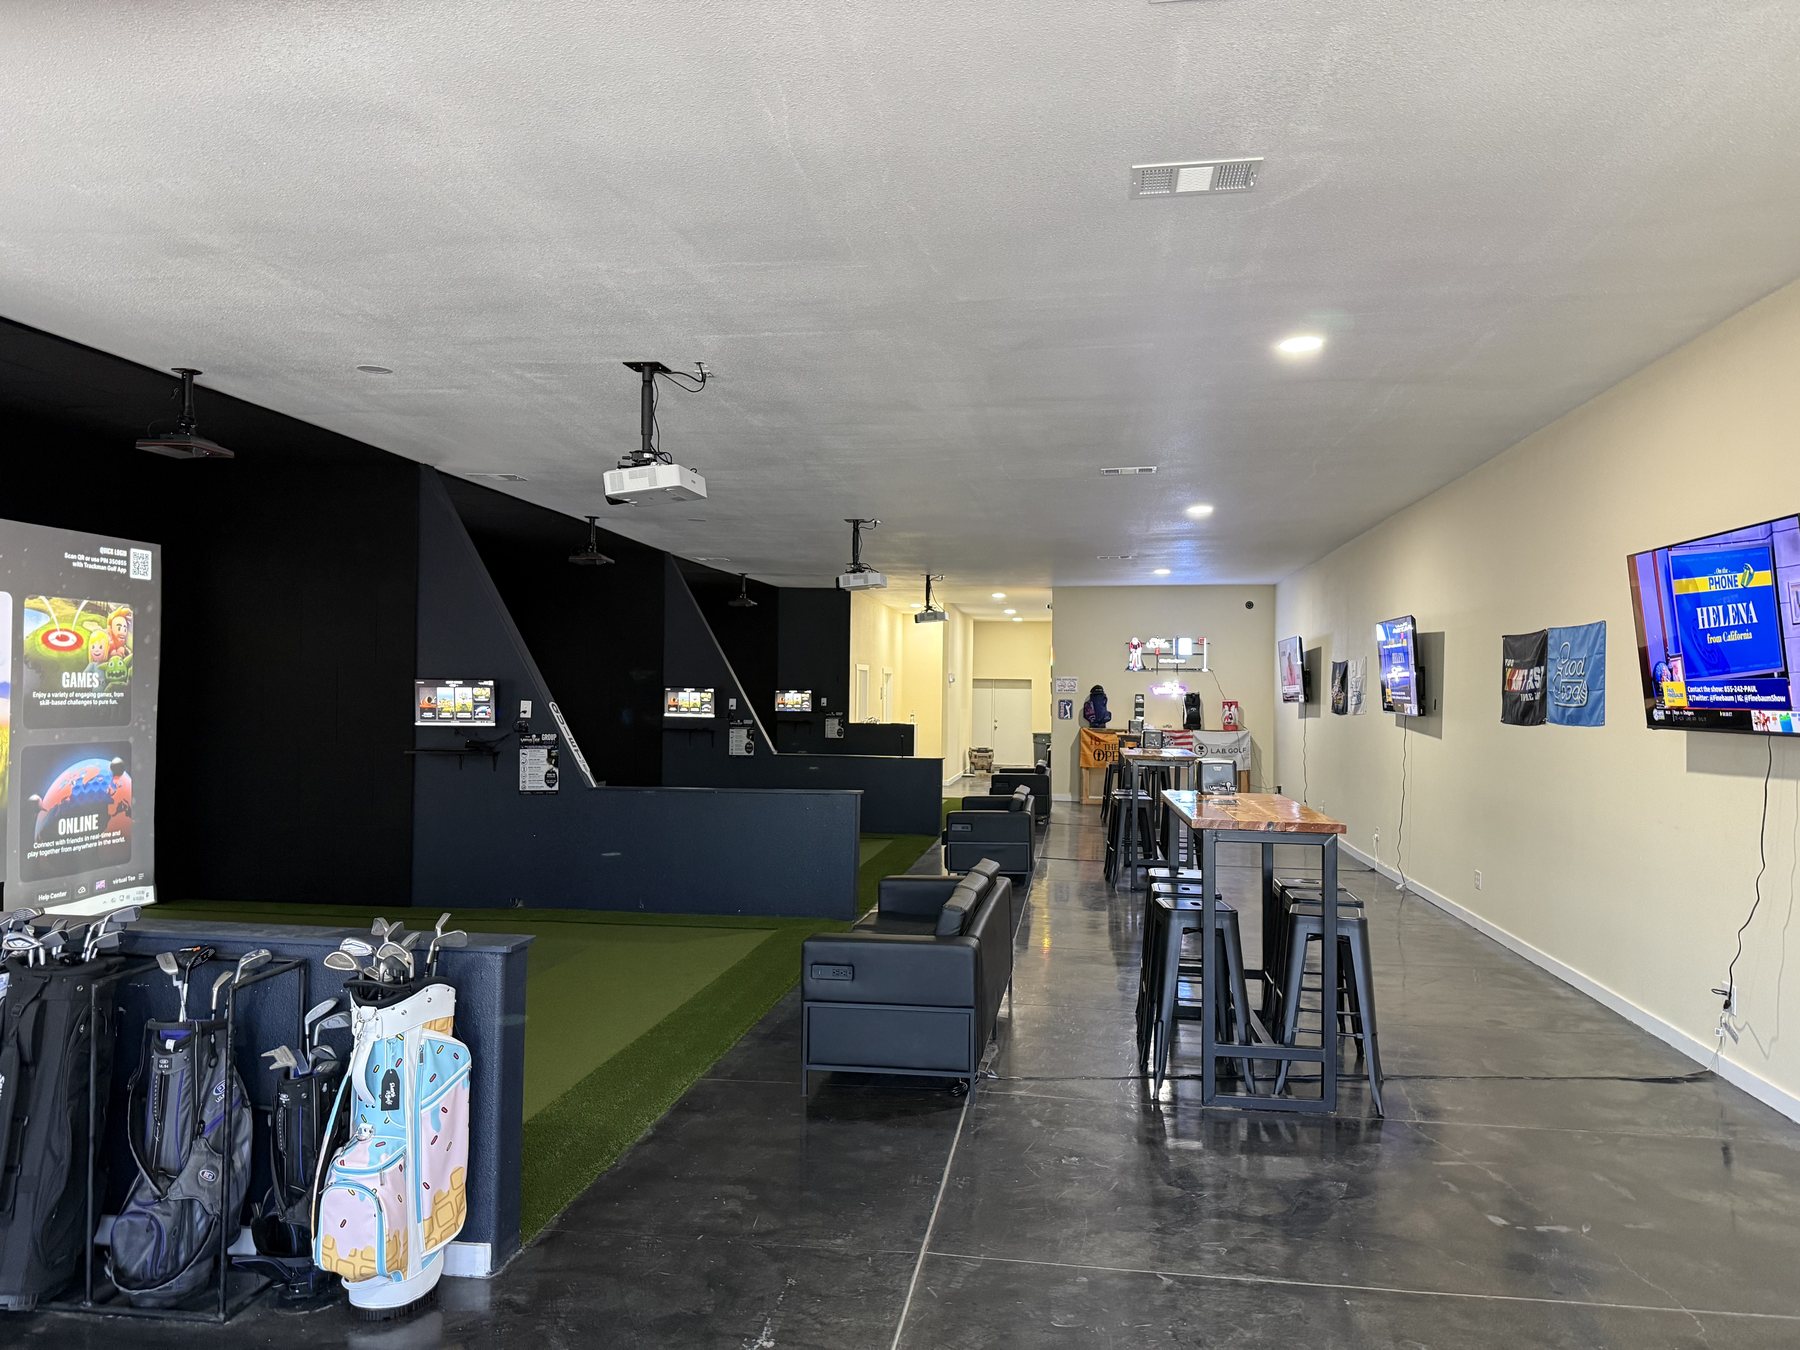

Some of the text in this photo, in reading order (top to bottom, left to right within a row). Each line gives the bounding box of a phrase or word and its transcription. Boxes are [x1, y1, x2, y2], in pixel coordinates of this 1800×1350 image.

[1708, 575, 1738, 590] PHONE
[1696, 601, 1758, 629] HELENA
[1707, 629, 1752, 644] from California
[62, 672, 99, 688] GAMES
[1093, 748, 1119, 761] OPE
[58, 814, 98, 835] ONLINE
[90, 832, 111, 840] real-time
[27, 851, 38, 859] play
[39, 848, 60, 856] together
[73, 841, 97, 851] anywhere
[50, 891, 67, 899] Center
